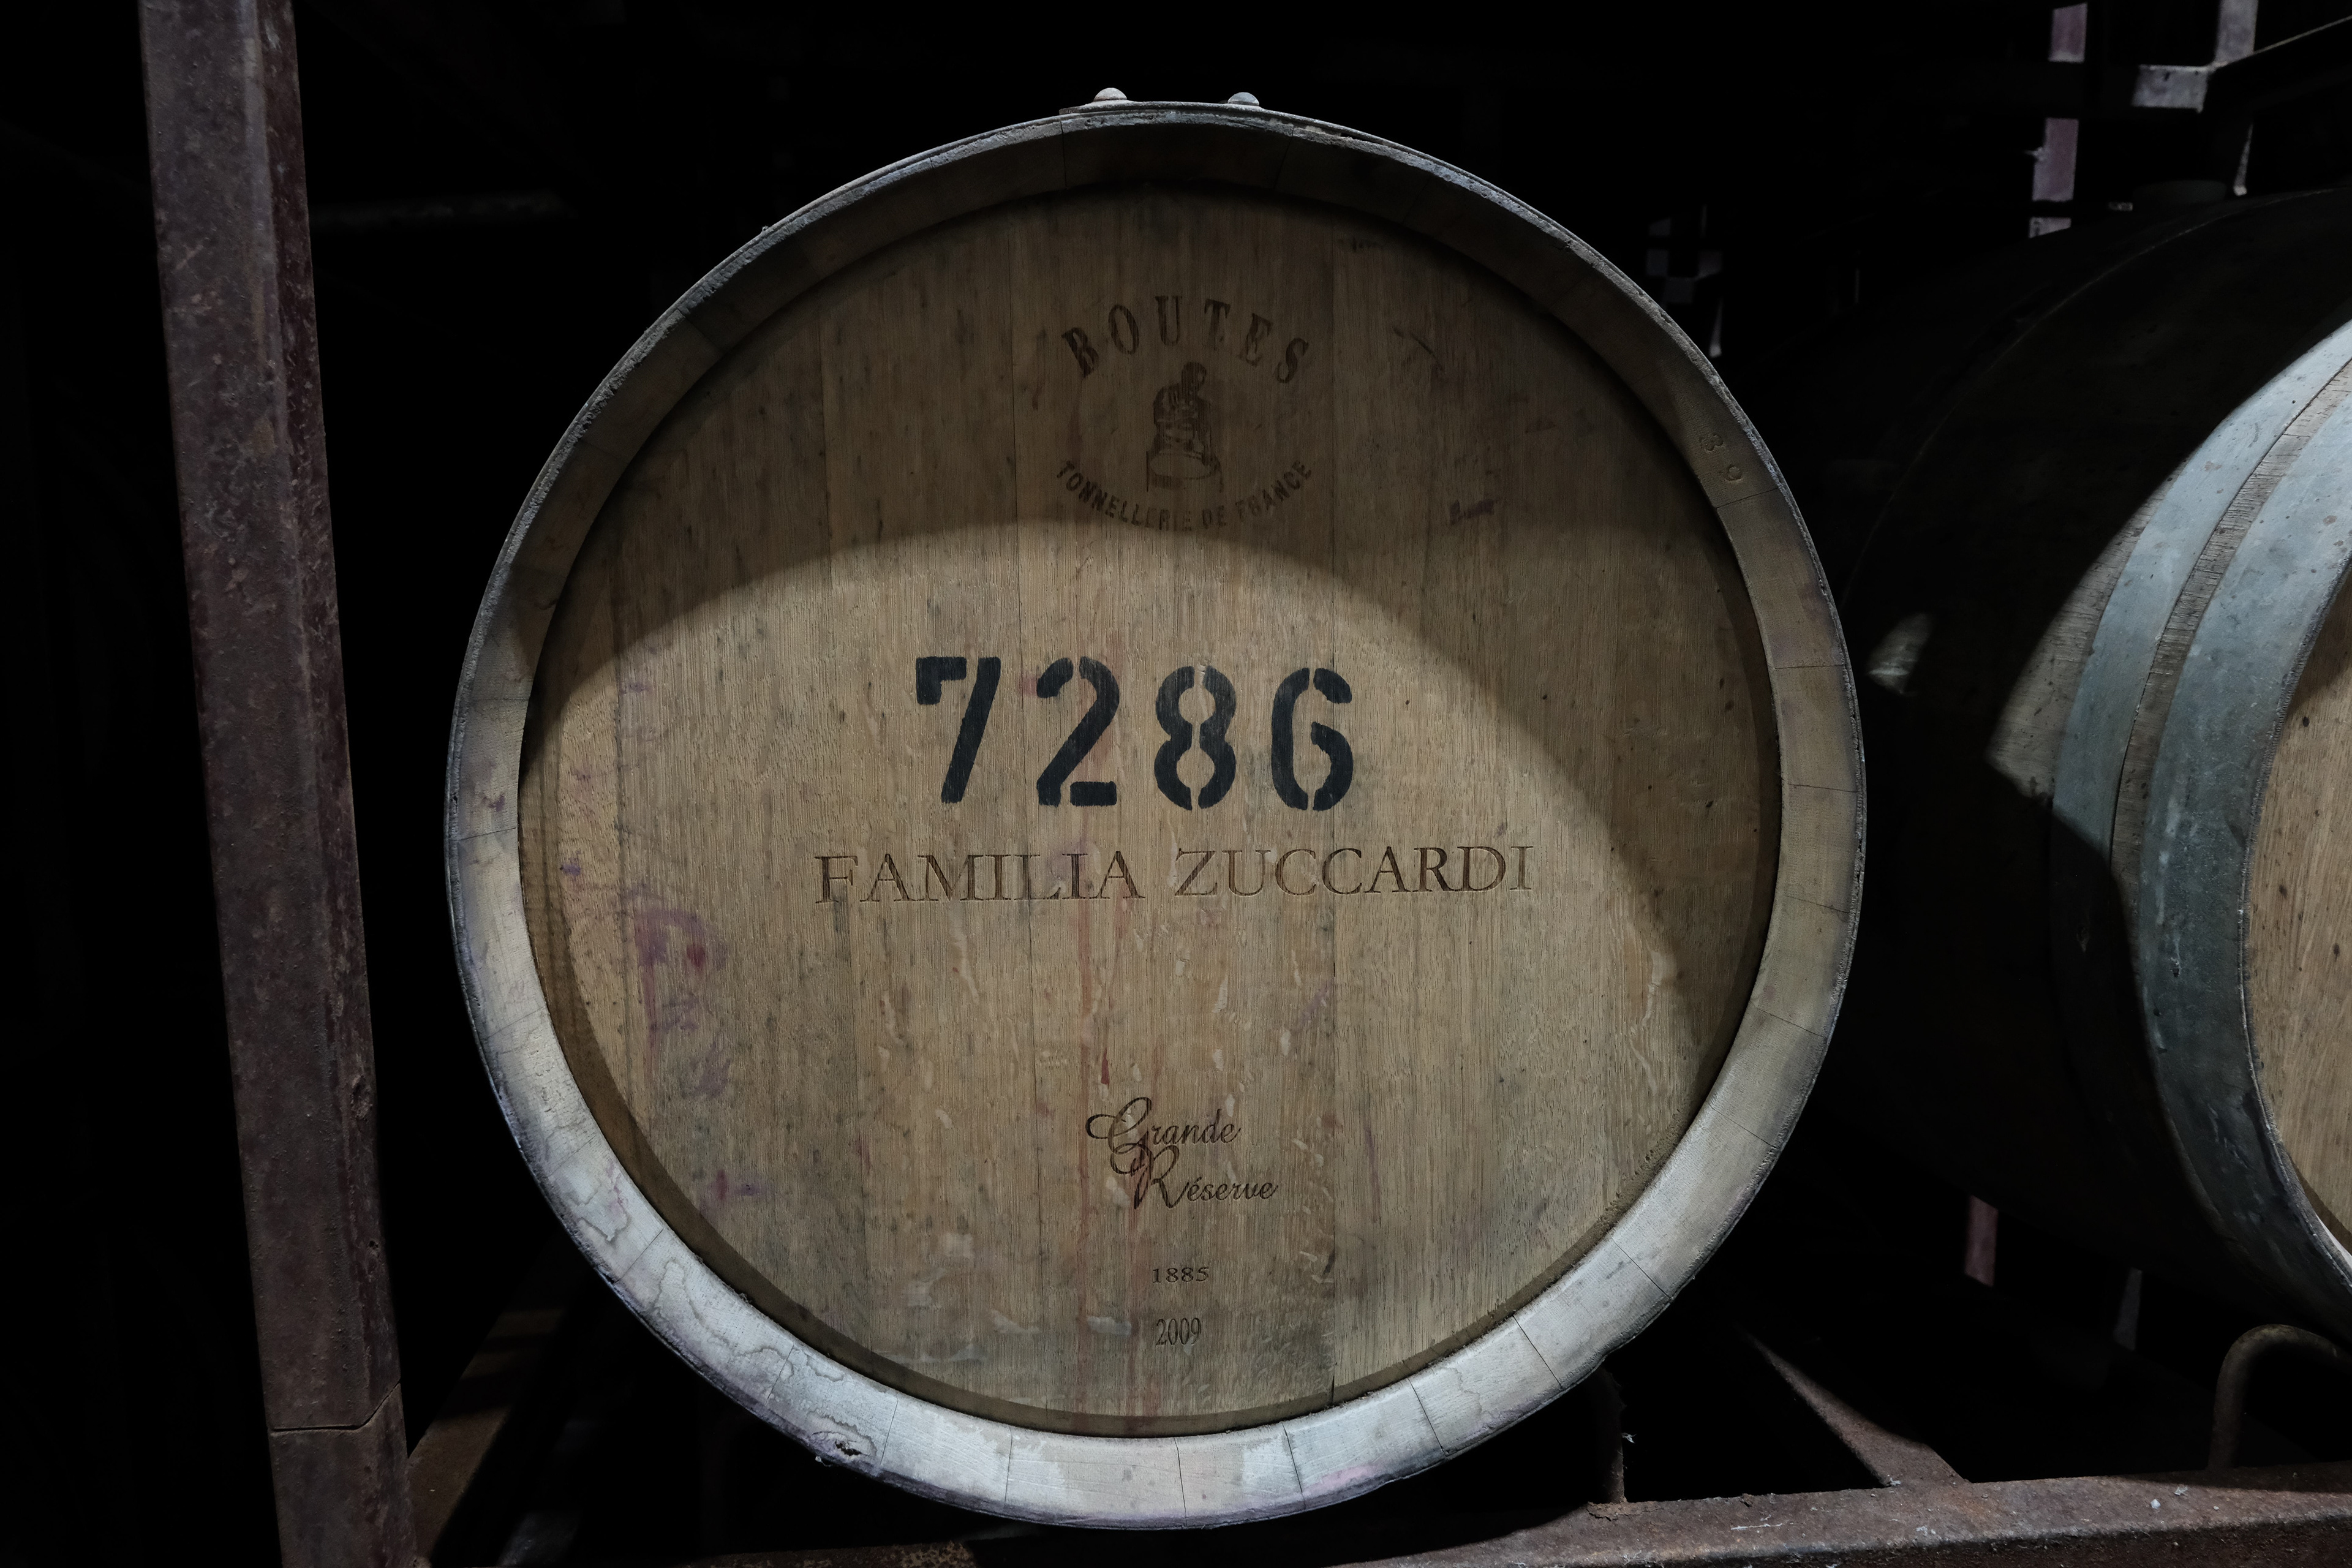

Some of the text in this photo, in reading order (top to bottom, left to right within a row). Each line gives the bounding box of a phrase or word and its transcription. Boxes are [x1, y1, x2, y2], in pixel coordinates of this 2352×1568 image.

[1061, 295, 1310, 383] BOUTES
[1201, 505, 1226, 529] DE
[1235, 461, 1312, 519] FRANCE
[916, 655, 1354, 811] 7286
[815, 845, 1534, 903] FAMILIA ZUCCARDI
[1085, 1097, 1242, 1177] Grande
[1110, 1143, 1279, 1210] Réserve
[1153, 1267, 1210, 1284] 1885
[1156, 1317, 1202, 1346] 2009
